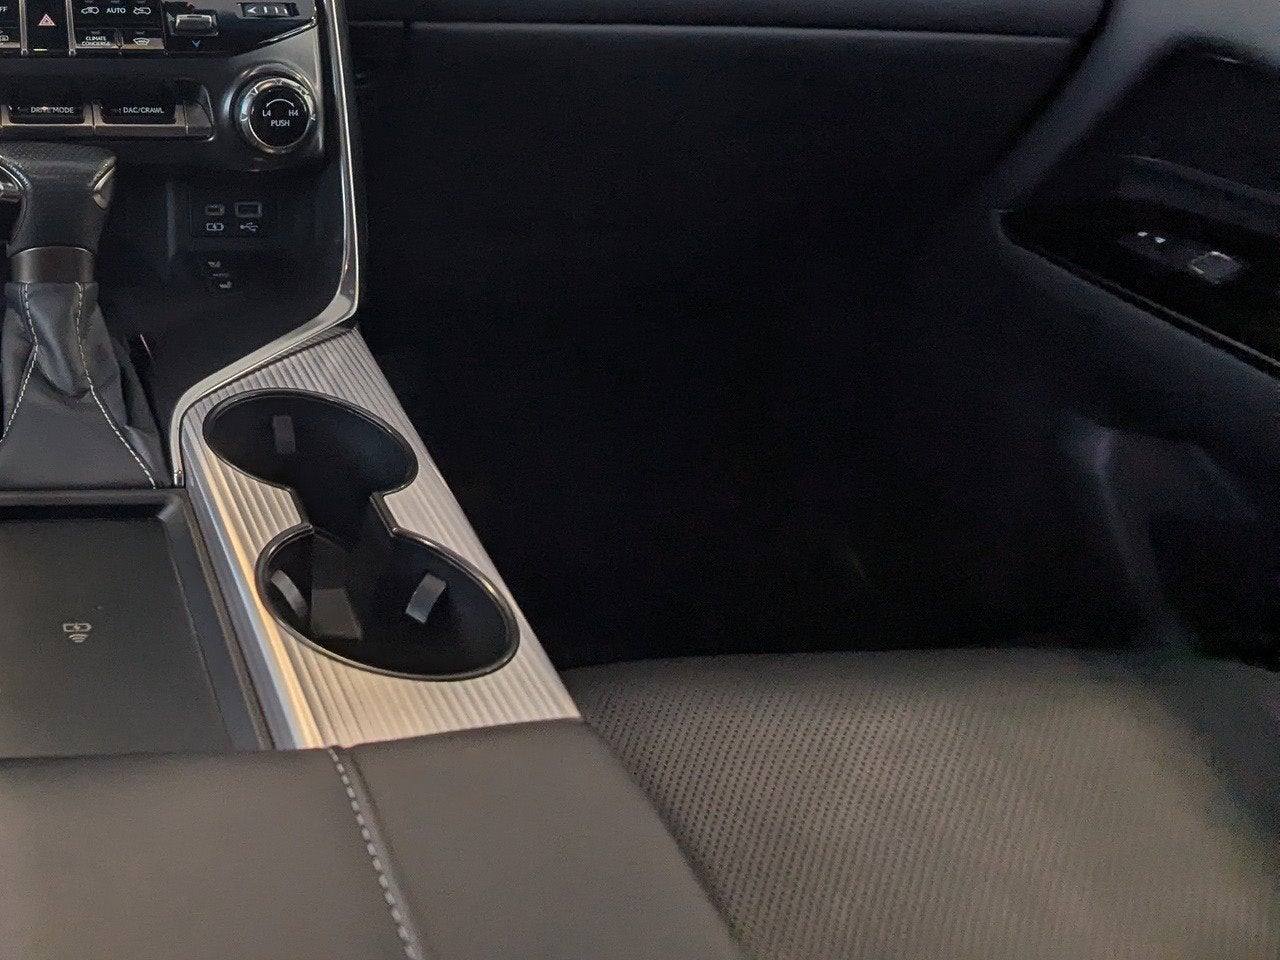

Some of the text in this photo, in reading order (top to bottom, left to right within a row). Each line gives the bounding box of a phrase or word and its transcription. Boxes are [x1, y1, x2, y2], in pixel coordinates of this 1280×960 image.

[106, 7, 126, 15] AUTO
[52, 106, 74, 114] MODE
[123, 106, 165, 115] DAC/CRAWL
[288, 109, 299, 117] H4
[270, 119, 290, 127] PUSH
